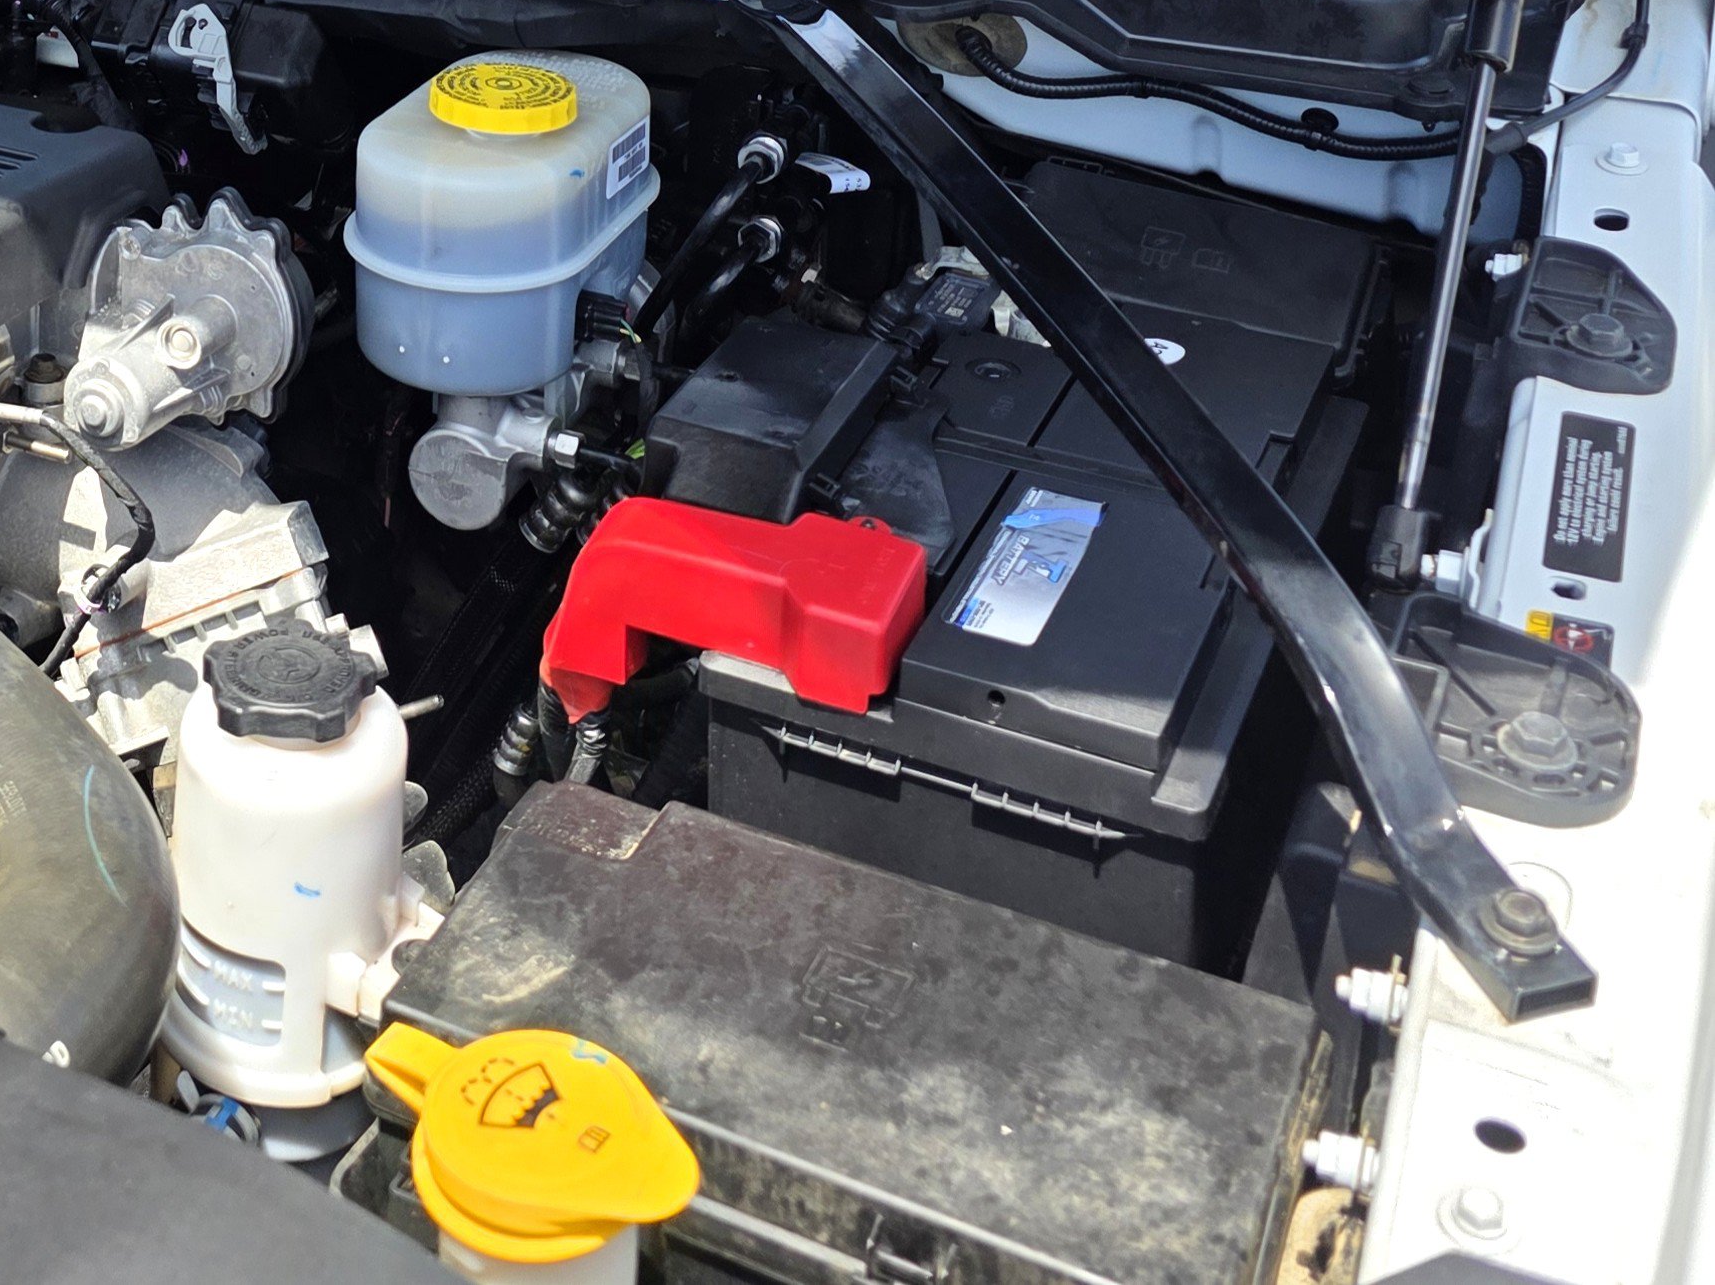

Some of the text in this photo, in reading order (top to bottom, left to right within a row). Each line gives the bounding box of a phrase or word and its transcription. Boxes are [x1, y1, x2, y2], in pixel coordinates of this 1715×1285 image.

[992, 534, 1030, 585] BATTERY
[213, 960, 253, 991] MAX
[214, 998, 253, 1030] MIN
